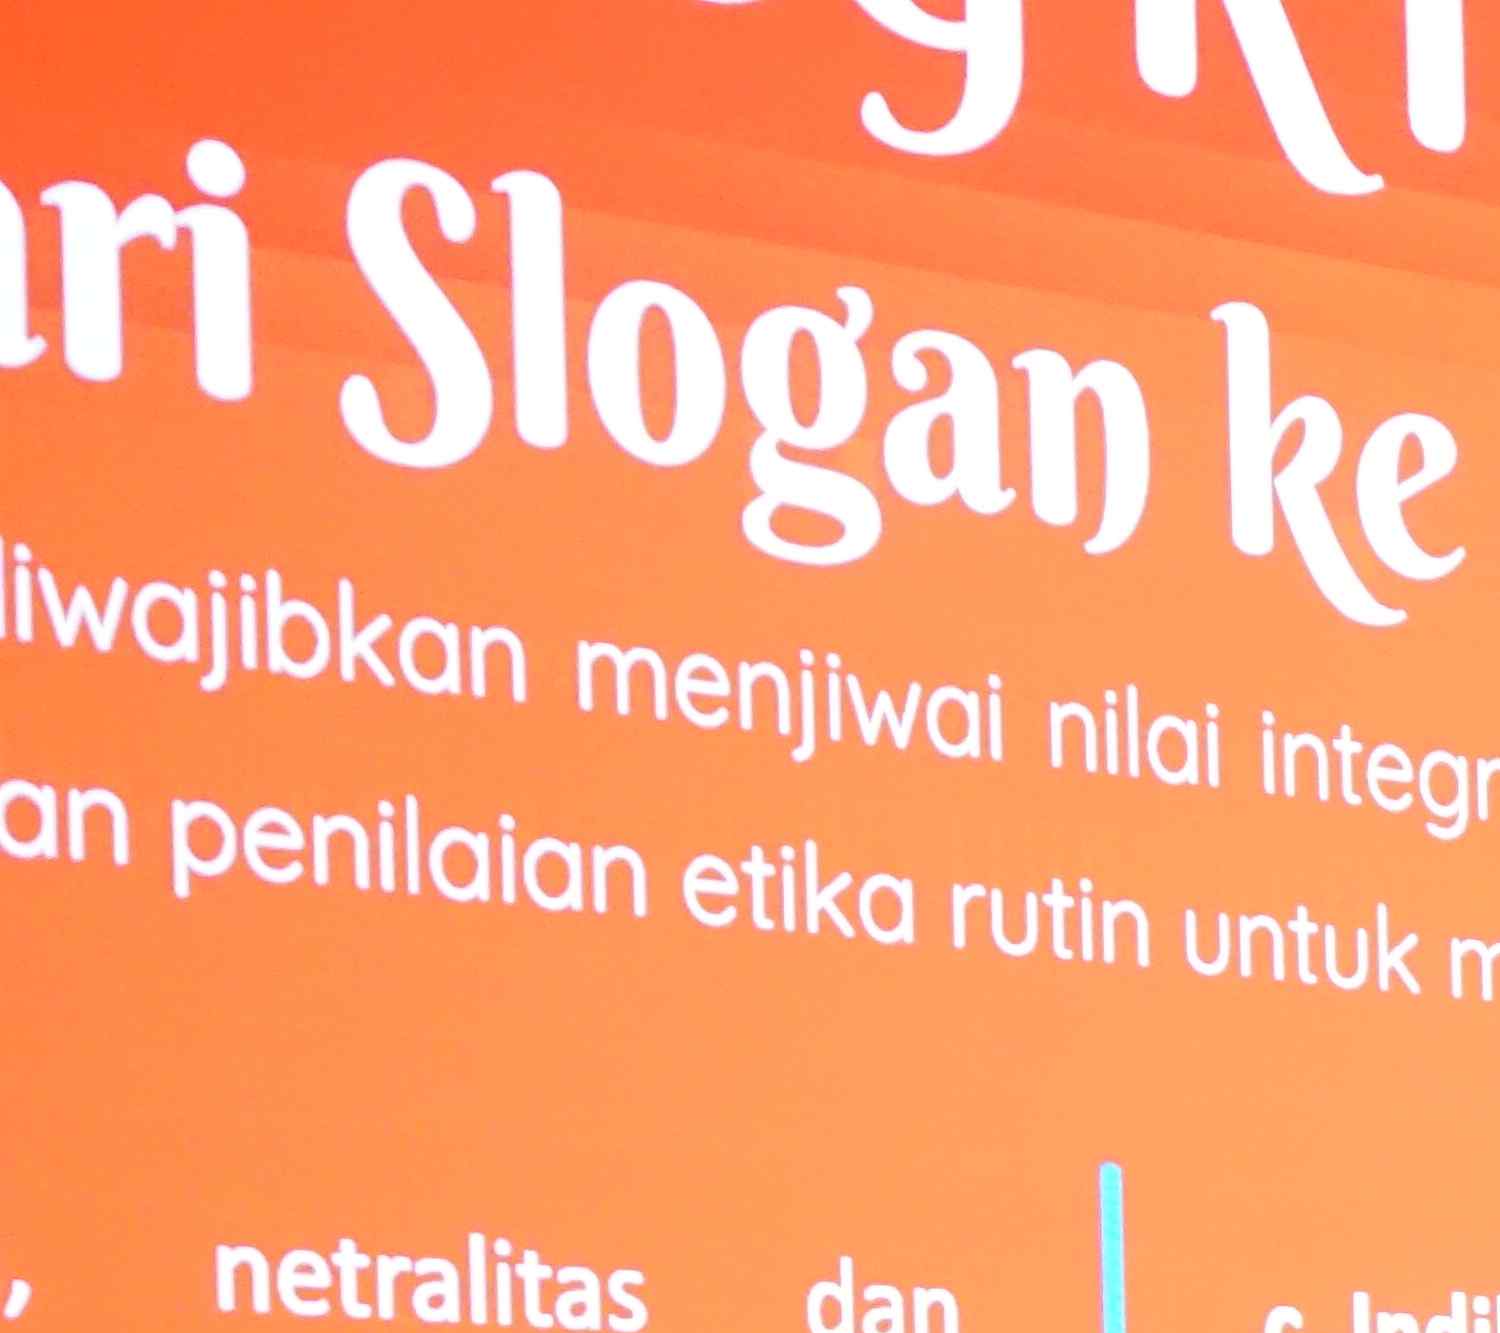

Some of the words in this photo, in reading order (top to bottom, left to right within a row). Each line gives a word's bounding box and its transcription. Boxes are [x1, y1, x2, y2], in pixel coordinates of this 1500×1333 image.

[339, 158, 1151, 567] Slogan
[1209, 300, 1467, 628] ke
[0, 537, 527, 704] iwajibkan
[576, 639, 1004, 764] menjiwai
[1048, 683, 1221, 789] nilai
[170, 794, 648, 919] penilaian
[681, 838, 915, 946] etika
[951, 877, 1151, 969] rutin
[1183, 902, 1422, 996] untuk
